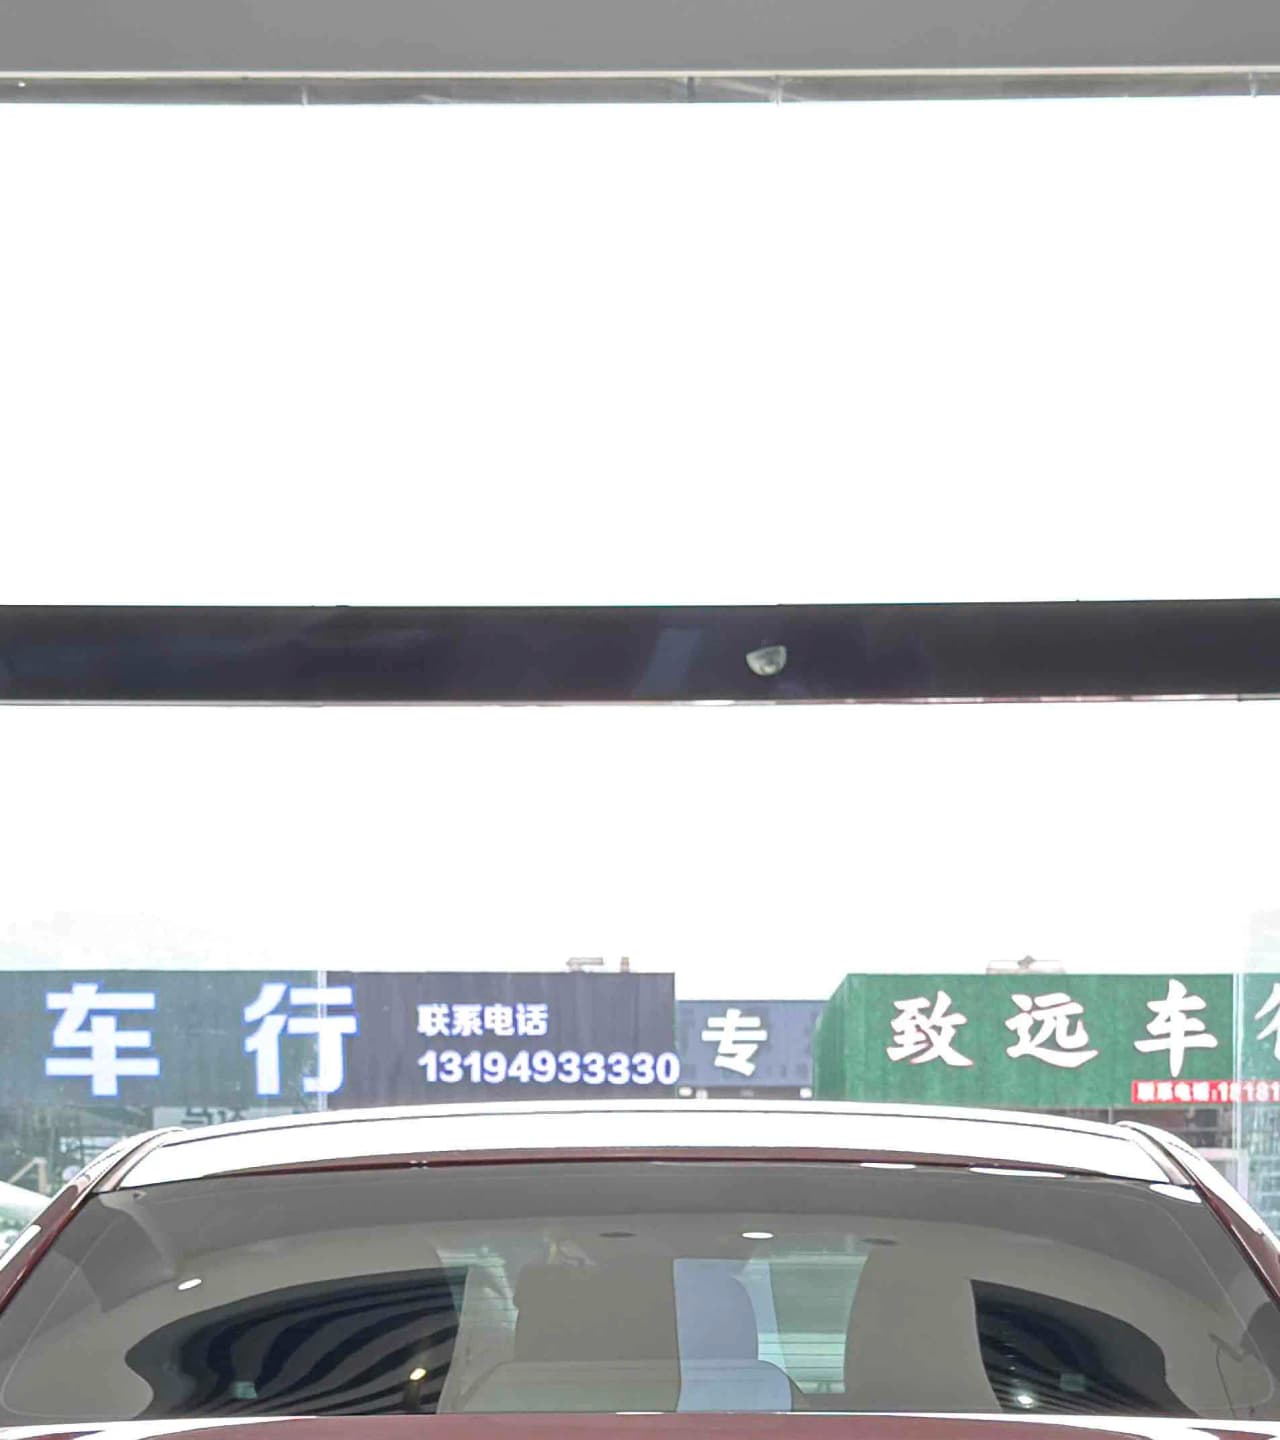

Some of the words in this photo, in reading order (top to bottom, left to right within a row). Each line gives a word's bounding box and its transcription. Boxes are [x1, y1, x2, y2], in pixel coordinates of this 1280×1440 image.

[416, 1003, 549, 1039] 联系电话
[701, 1007, 769, 1077] 专
[417, 1049, 681, 1086] 13194933330
